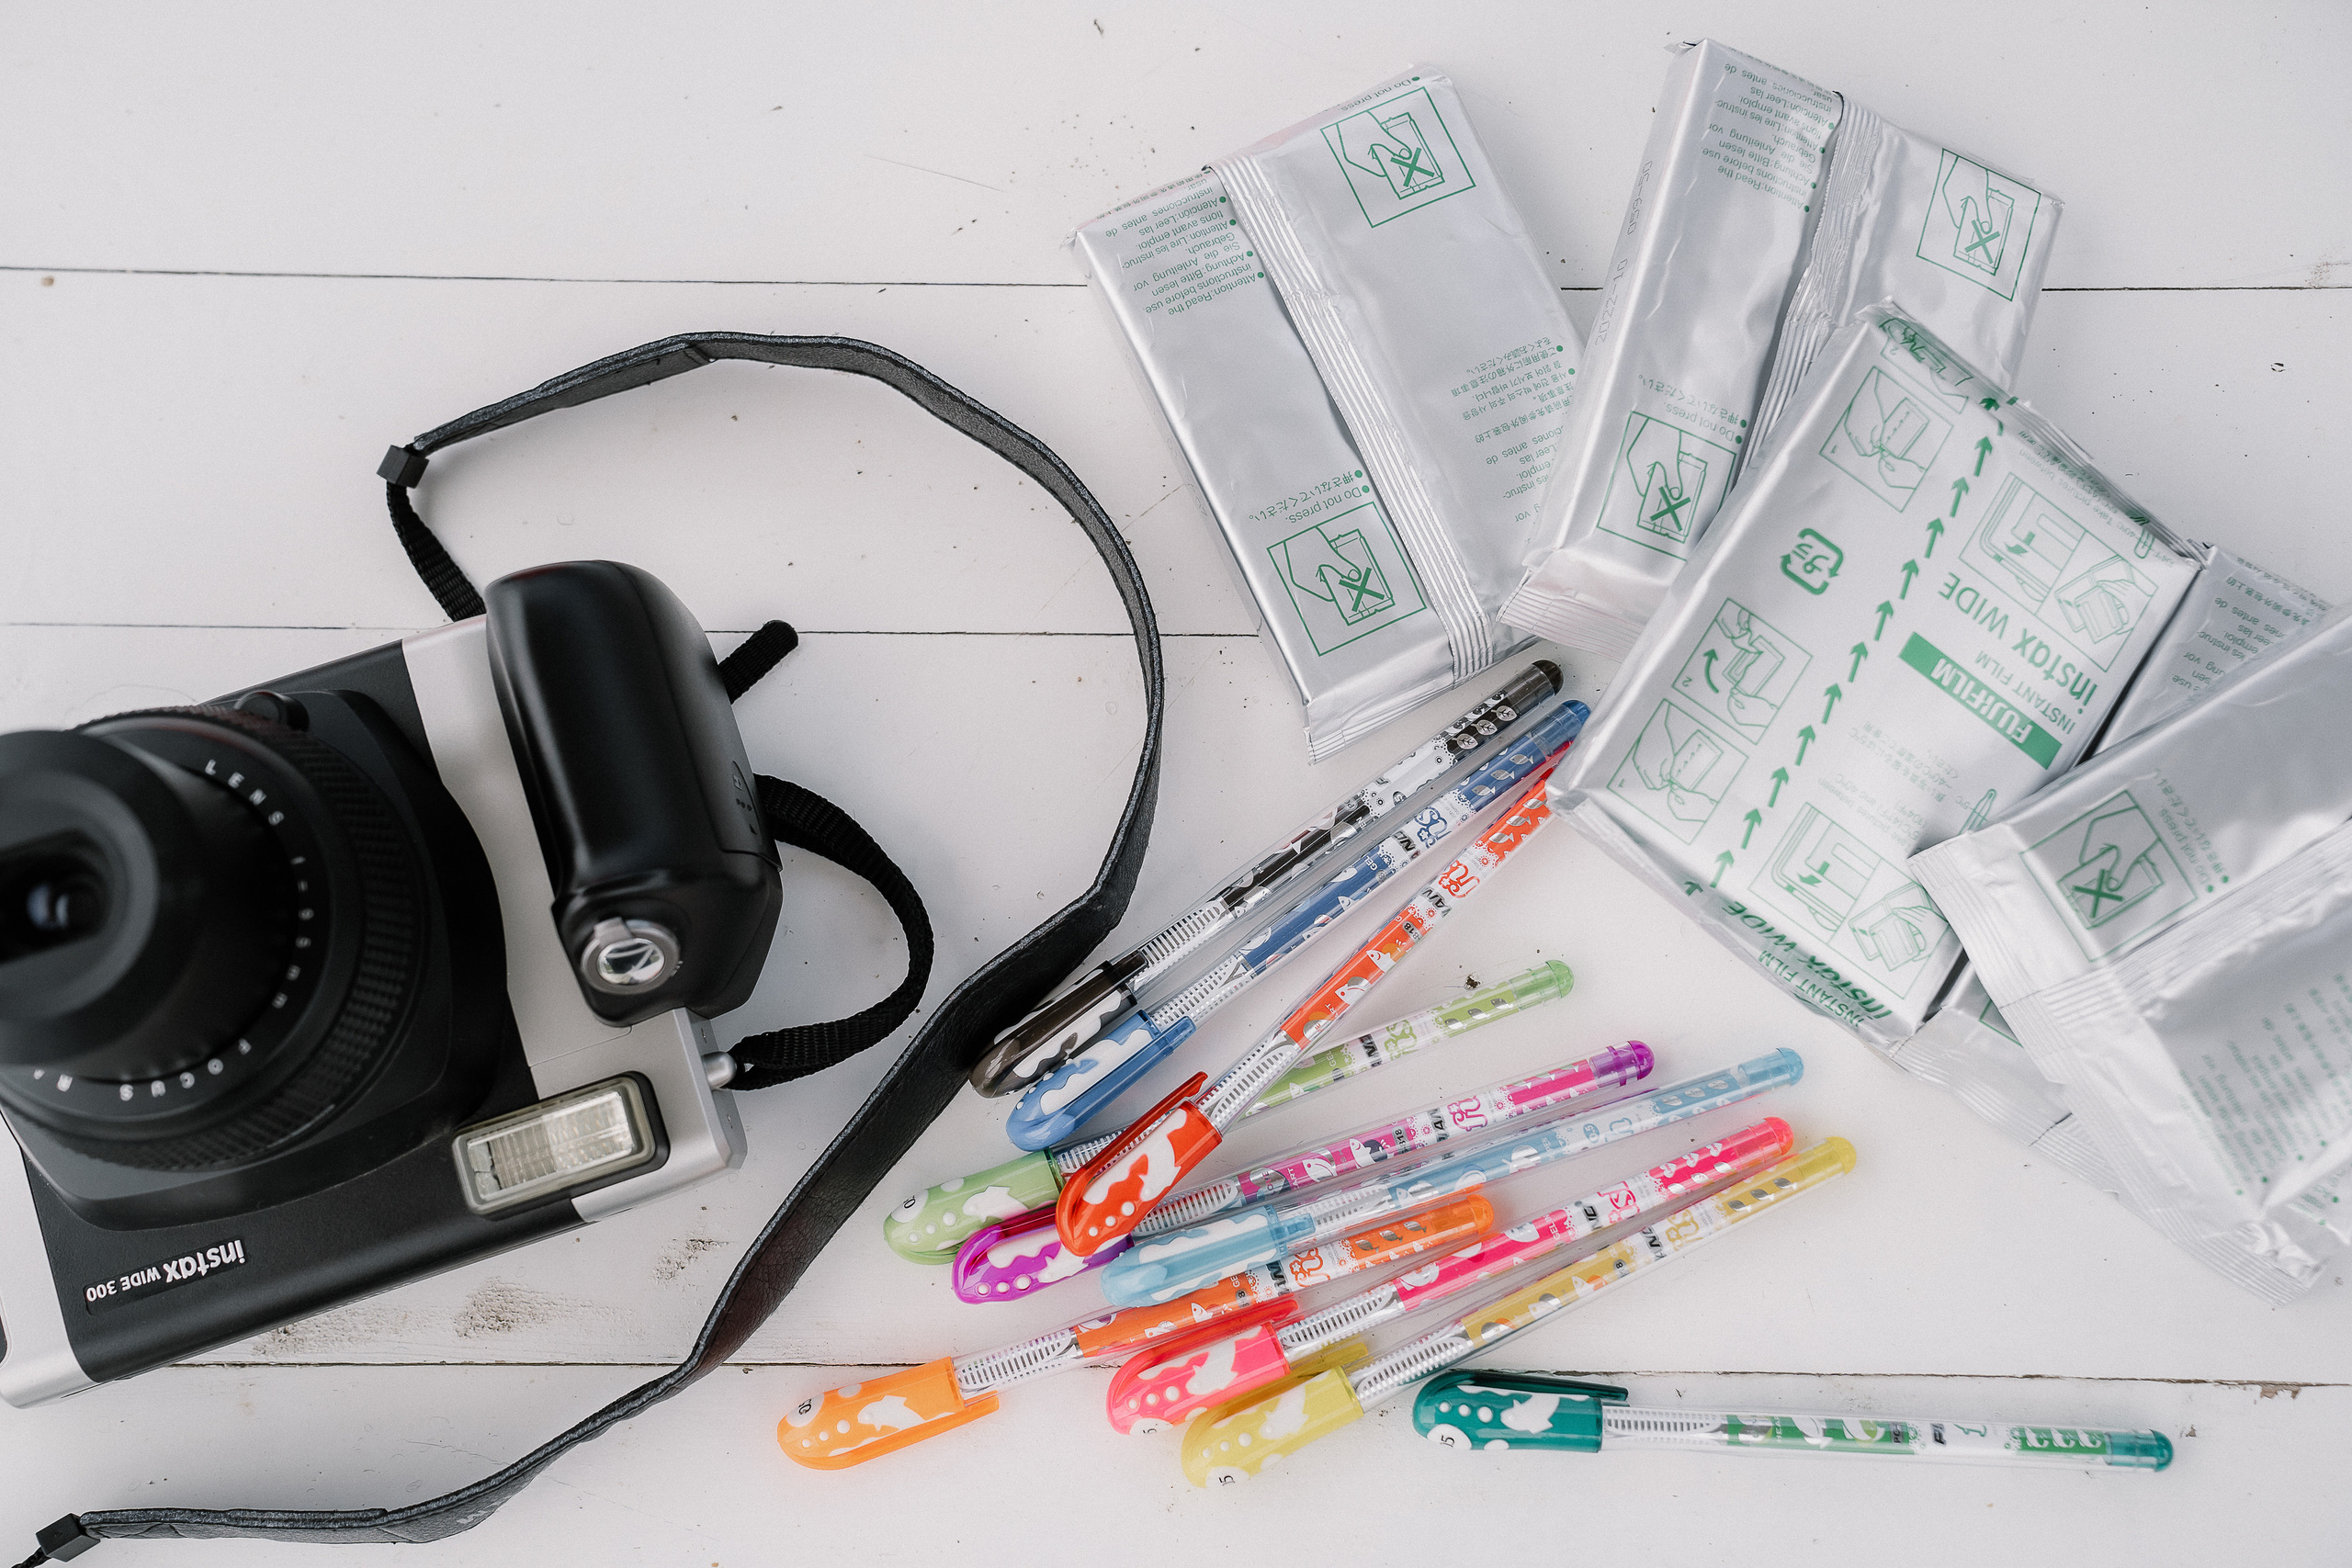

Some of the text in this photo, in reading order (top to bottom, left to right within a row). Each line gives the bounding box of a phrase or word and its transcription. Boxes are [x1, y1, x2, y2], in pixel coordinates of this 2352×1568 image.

[1373, 86, 1393, 98] not
[1393, 78, 1412, 88] Do
[1724, 62, 1832, 113] instrucciones antes de
[1749, 85, 1765, 100] las
[1714, 99, 1819, 152] Attention:Lire les instruc-
[1739, 96, 1821, 141] tions avant emploi.
[1708, 122, 1814, 175] Sie die Anleitung vor
[1718, 140, 1811, 186] Achtung:Bitte lesen
[1771, 133, 1816, 164] Gebrauch.
[1183, 177, 1208, 191] usar.
[1702, 147, 1807, 197] instructions before use.
[1717, 165, 1804, 209] Attention:Read the
[1104, 186, 1214, 238] instrucciones antes de
[1137, 209, 1224, 253] tions avant emploi.
[1138, 197, 1218, 236] Atención:Leer las
[1122, 220, 1228, 269] Attention:Lire les instruc-
[1184, 231, 1236, 255] Gebrauch.
[1133, 242, 1240, 292] Sie die Anleitung vor
[1145, 263, 1253, 314] instructions before use.
[1151, 252, 1245, 297] Achtung:Bitte lesen
[1168, 272, 1256, 316] Attention:Read the
[1594, 254, 1629, 346] 2022-10
[1474, 394, 1574, 445] 用前请先参阅外包装上的
[1663, 401, 1736, 442] Do not press.
[1485, 441, 1529, 466] antes de
[1515, 460, 1552, 482] emploi.
[1519, 453, 1535, 465] las
[1829, 445, 1838, 455] 1
[1249, 470, 1354, 522] 押さないでください。
[1284, 486, 1363, 524] Do not press.
[1502, 479, 1535, 499] instruc-
[1514, 511, 1532, 523] vor
[1938, 571, 2098, 715] instax WIDE
[1681, 675, 1693, 688] 2
[1974, 650, 2076, 735] INSTANT FILM
[2190, 670, 2212, 685] sen
[1927, 654, 2035, 747] FUJIFILM
[204, 759, 285, 826] LENS
[1617, 776, 1625, 788] 1
[1402, 921, 1421, 942] -818
[1719, 895, 1894, 1028] instax WIDE
[1758, 949, 1866, 1032] INSTANT FILM
[85, 1239, 246, 1303] instax WIDE 300
[1606, 1244, 1620, 1259] GE
[1229, 1274, 1241, 1289] GE
